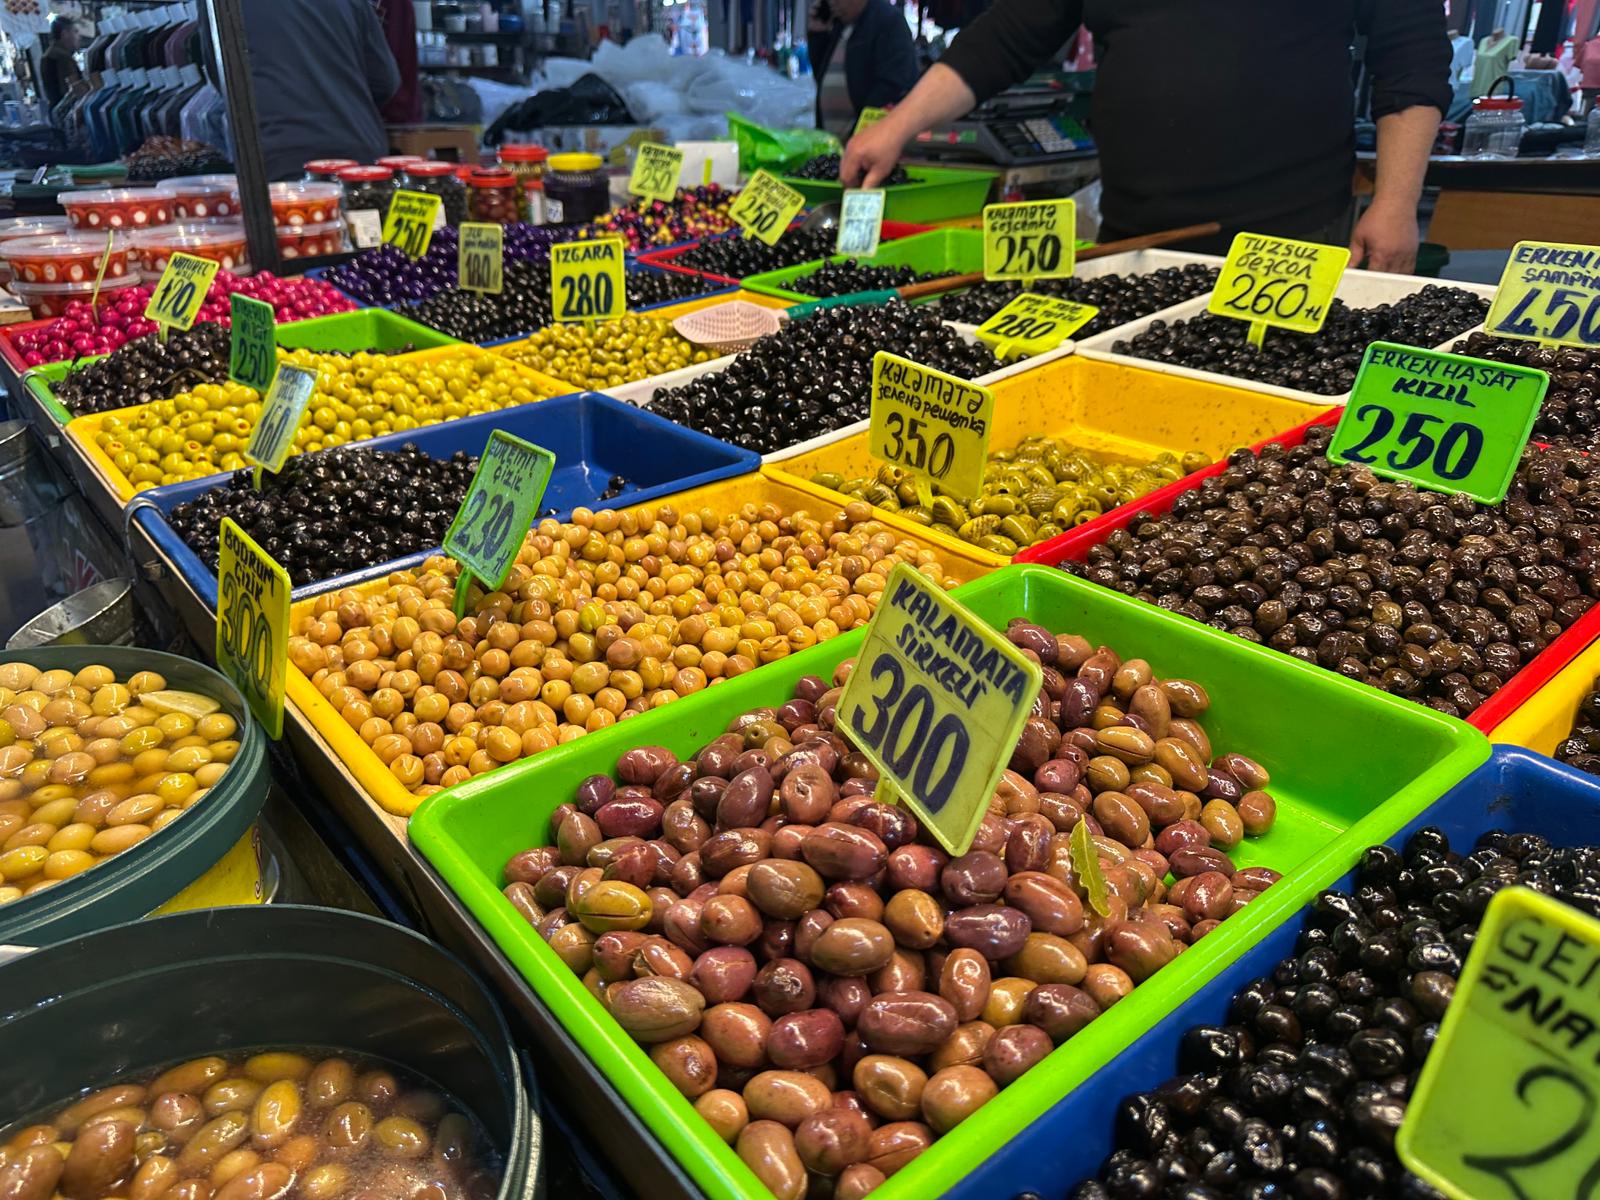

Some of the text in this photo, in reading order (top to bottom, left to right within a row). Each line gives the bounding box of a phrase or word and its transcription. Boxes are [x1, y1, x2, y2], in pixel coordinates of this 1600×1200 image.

[636, 168, 671, 193] 250
[737, 195, 779, 233] 250
[391, 217, 427, 257] 250
[994, 234, 1062, 275] 250
[1244, 237, 1319, 262] TUZSUZ
[1514, 247, 1595, 269] ERKEN
[561, 272, 613, 317] 280
[1224, 274, 1308, 319] 260
[985, 314, 1056, 340] 280
[235, 338, 268, 386] 250
[1369, 350, 1523, 392] ERKEN HASAT
[1391, 377, 1476, 408] KIZIL
[884, 412, 955, 480] 350
[1340, 404, 1484, 481] 250
[454, 489, 515, 561] 230
[223, 526, 275, 597] BODRUM
[222, 572, 273, 700] 300
[891, 578, 1028, 705] KALAMATA
[852, 653, 971, 815] 300
